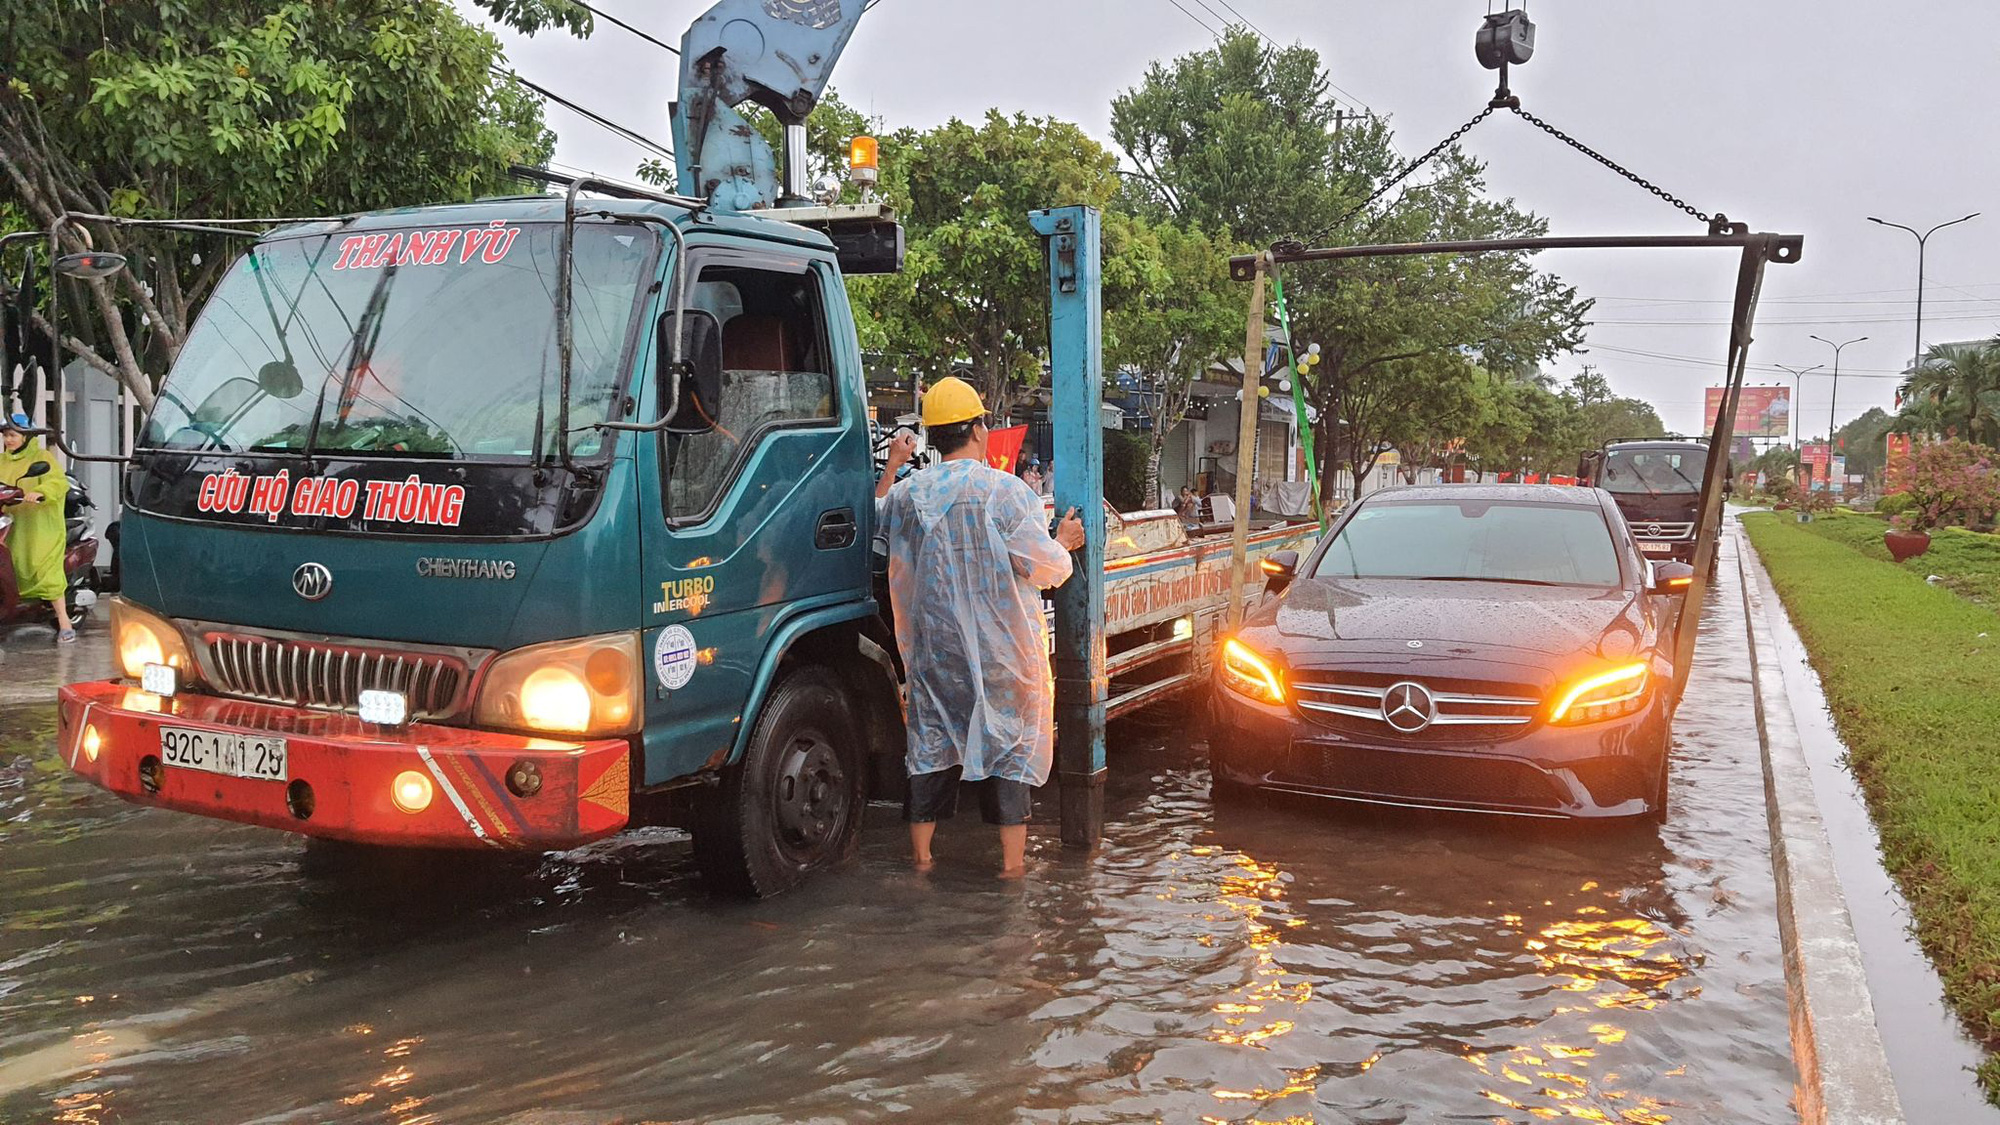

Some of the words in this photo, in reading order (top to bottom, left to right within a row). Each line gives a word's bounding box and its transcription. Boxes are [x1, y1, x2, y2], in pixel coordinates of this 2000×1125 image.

[333, 230, 460, 270] THANH
[459, 219, 520, 264] VŨ
[198, 468, 250, 514] CỨU
[250, 468, 289, 523] HỘ
[292, 476, 359, 519] GIAO
[363, 474, 466, 527] THÔNG
[416, 557, 516, 580] CHIENTHANG
[661, 575, 715, 611] TURBO
